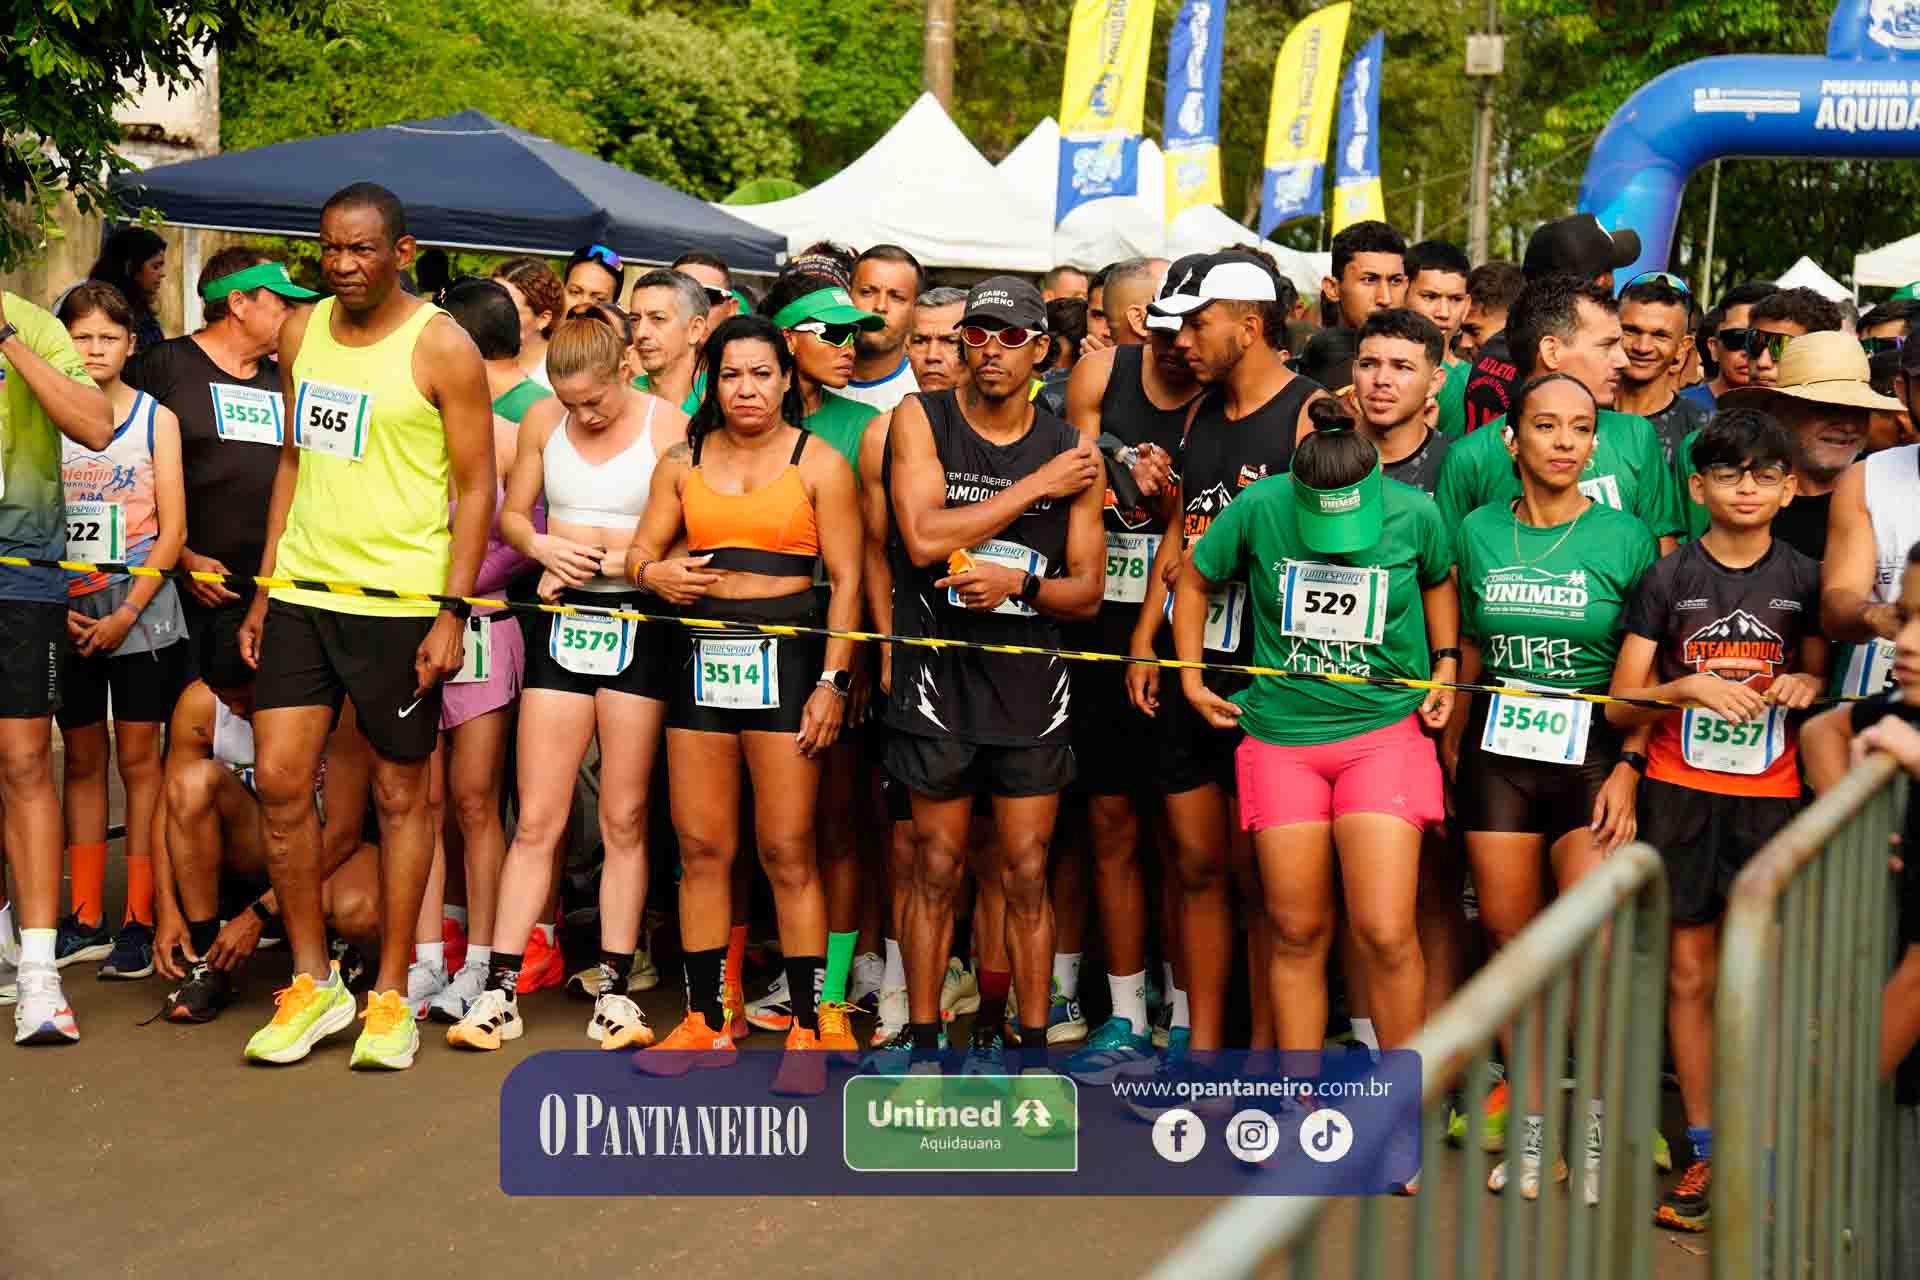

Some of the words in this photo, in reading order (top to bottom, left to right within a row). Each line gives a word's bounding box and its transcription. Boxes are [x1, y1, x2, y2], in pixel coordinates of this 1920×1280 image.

[223, 402, 272, 425] 3552
[309, 405, 348, 432] 565
[963, 472, 980, 482] QUE
[981, 474, 1012, 487] QUERER
[79, 491, 104, 502] ABA
[1106, 555, 1144, 578] 578
[1304, 590, 1357, 616] 529
[1485, 583, 1588, 608] UNIMED
[562, 627, 619, 652] 3579
[704, 661, 760, 685] 3514
[1499, 704, 1568, 735] 3540
[1693, 716, 1765, 746] 3557
